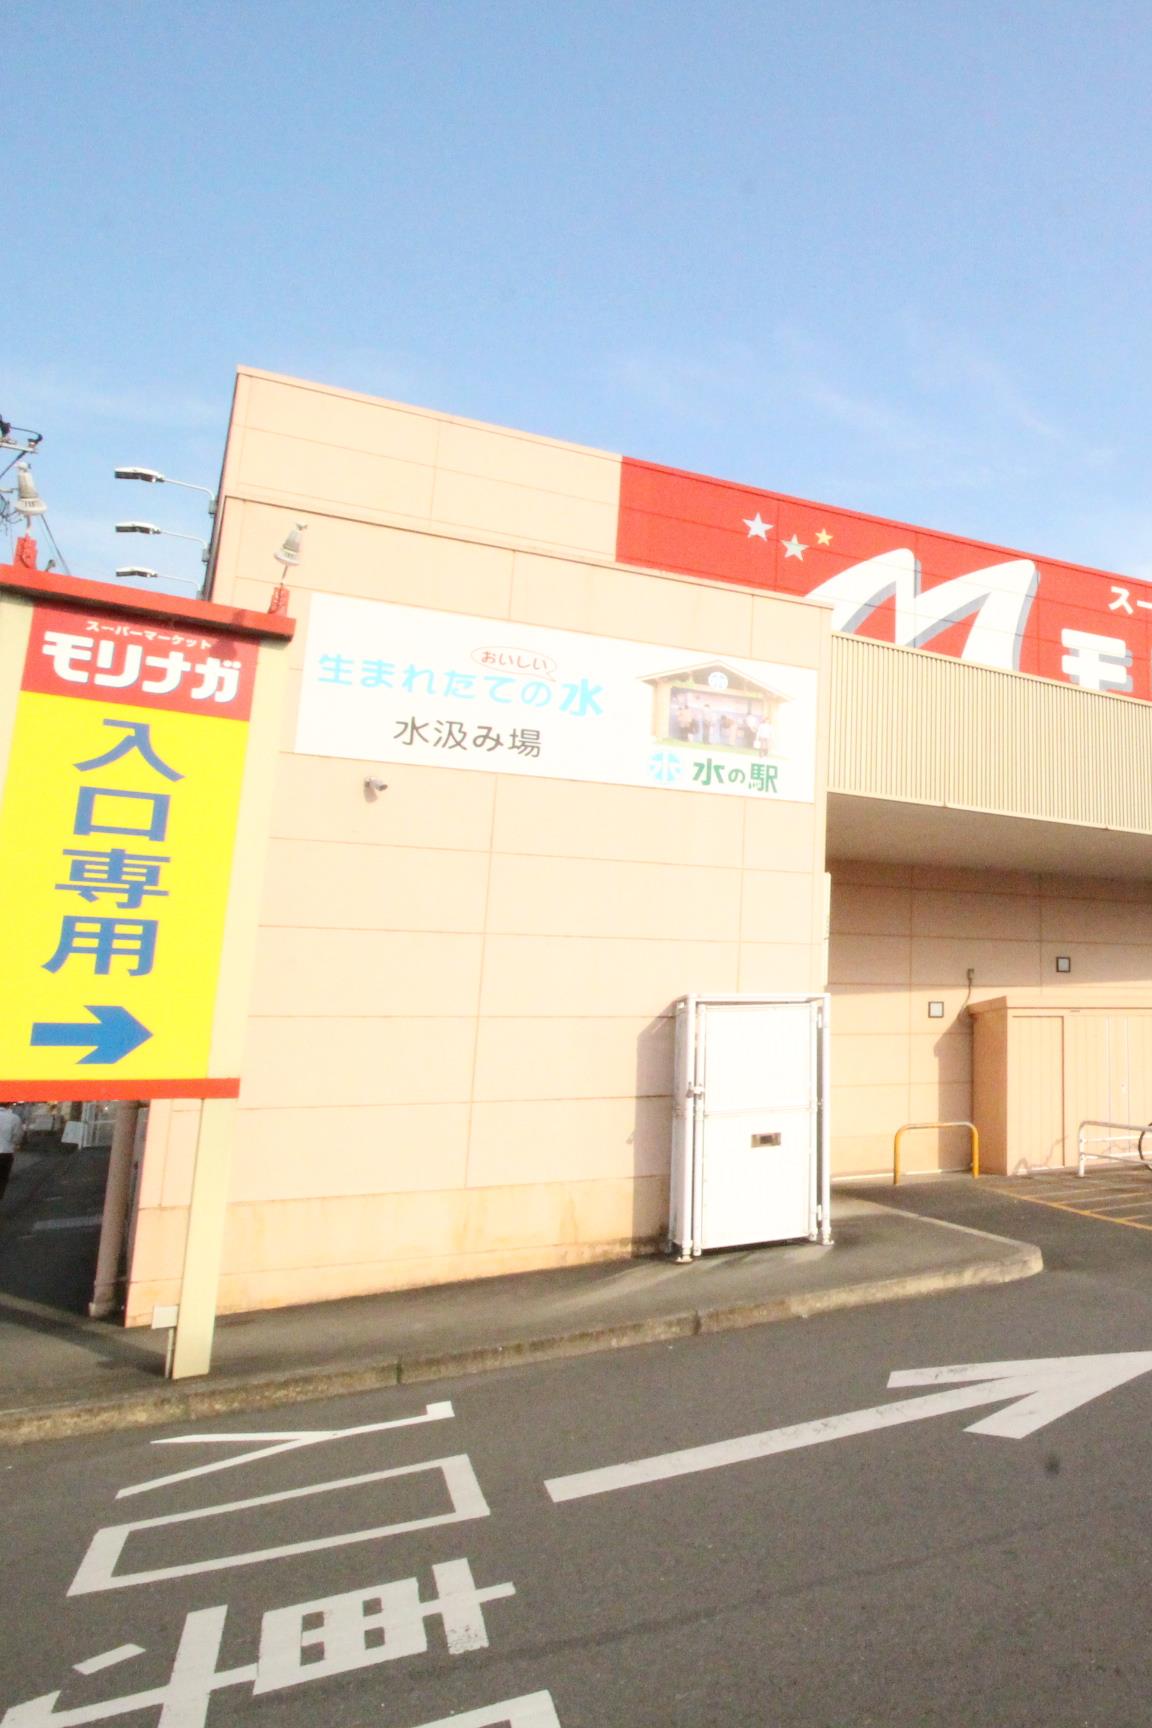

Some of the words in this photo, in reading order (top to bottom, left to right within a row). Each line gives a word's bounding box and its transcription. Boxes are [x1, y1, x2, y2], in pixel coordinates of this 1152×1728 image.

[86, 620, 212, 650] スーパーマーケット
[41, 630, 242, 703] モリナガ
[481, 650, 548, 671] おいしい
[317, 653, 604, 718] 生まれたての水
[393, 716, 542, 758] 水汲み場
[692, 758, 779, 793] 水の駅
[41, 718, 187, 977] 入口専用
